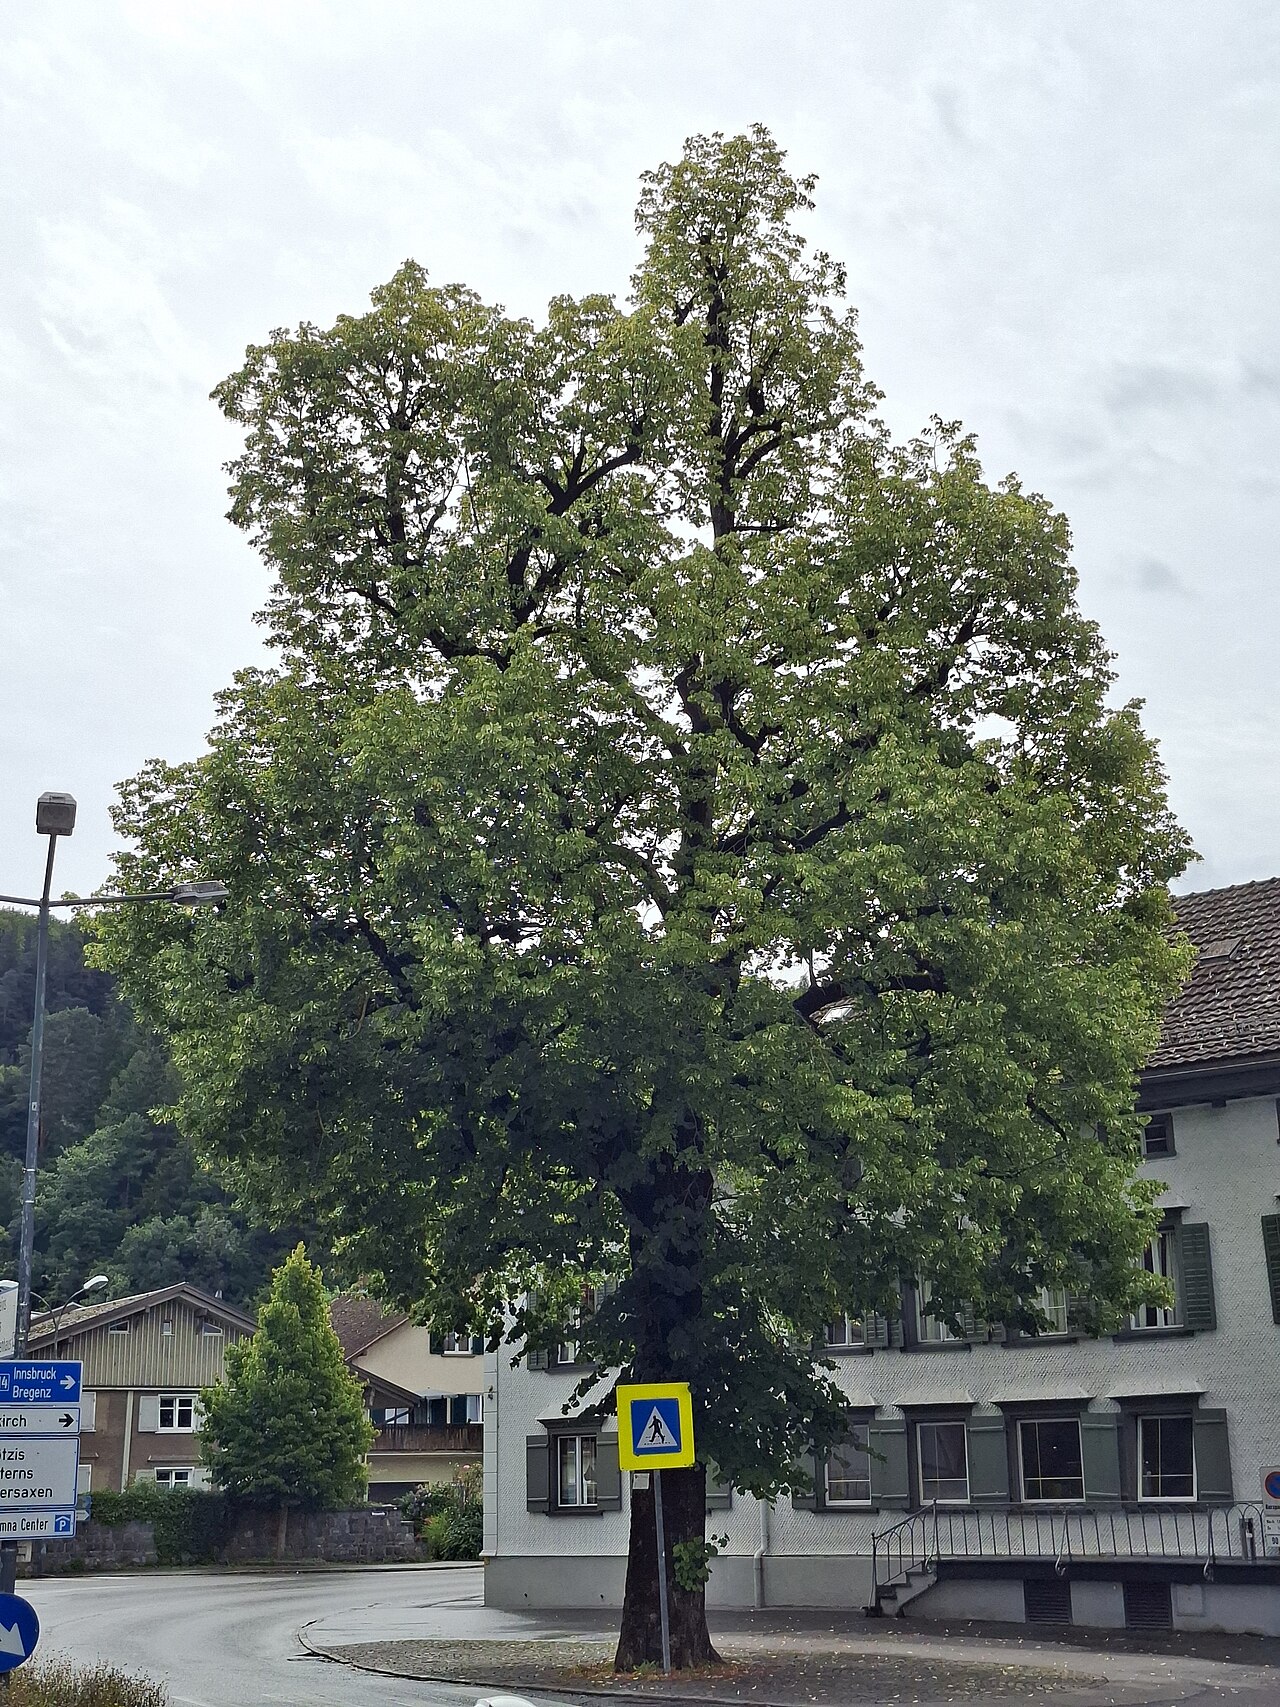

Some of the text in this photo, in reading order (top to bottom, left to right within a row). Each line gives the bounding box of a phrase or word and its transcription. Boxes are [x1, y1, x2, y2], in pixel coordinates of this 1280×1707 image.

[14, 1366, 56, 1380] Innsbruck
[13, 1385, 51, 1401] Bregenz
[0, 1448, 25, 1460] tzis
[21, 1518, 49, 1531] Center
